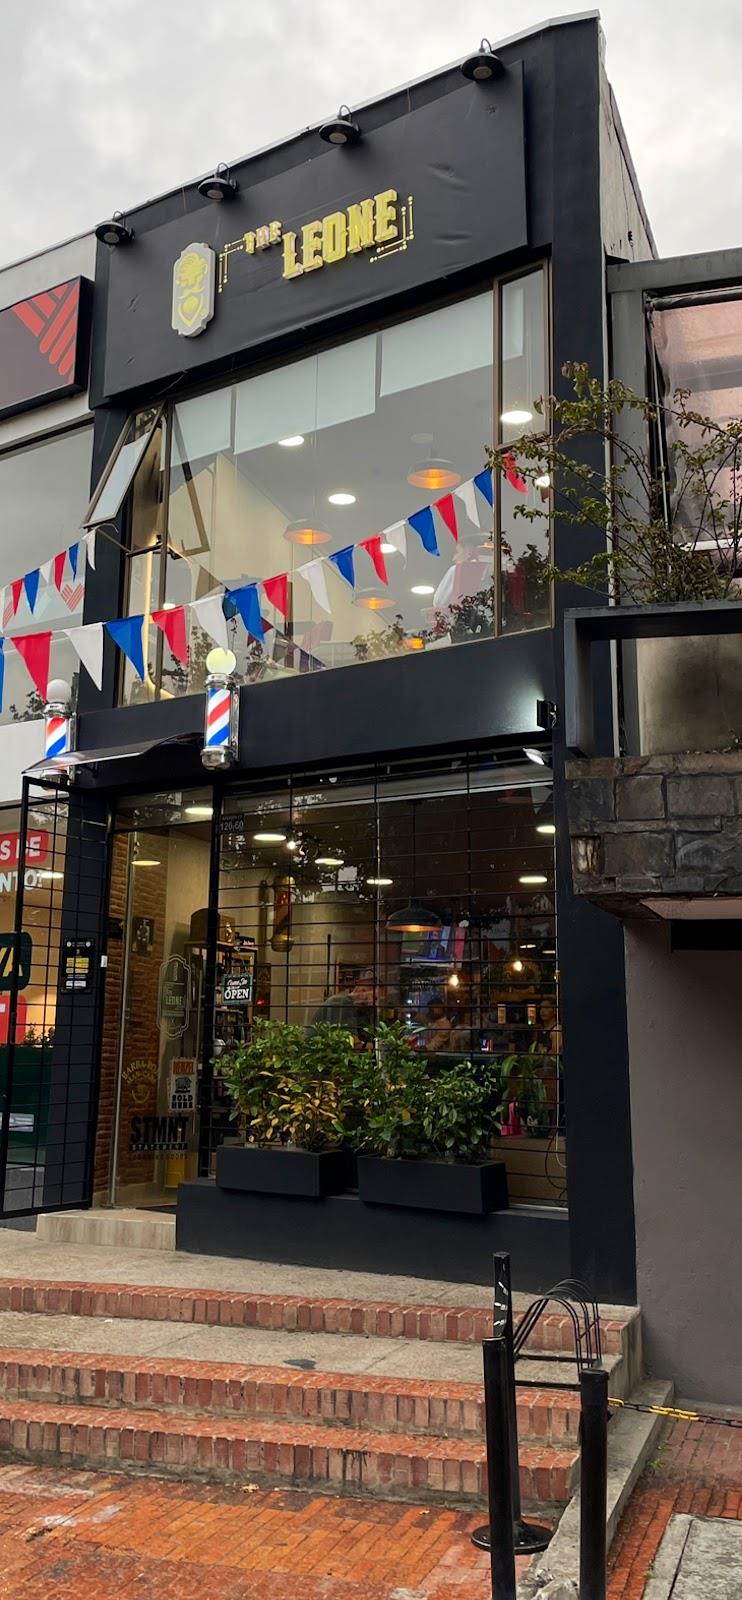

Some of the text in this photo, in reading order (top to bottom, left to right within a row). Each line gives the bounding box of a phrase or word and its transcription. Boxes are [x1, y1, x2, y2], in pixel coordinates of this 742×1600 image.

[243, 188, 398, 280] THE LEONE
[15, 836, 41, 858] DE
[224, 988, 249, 1000] OPEN
[172, 1094, 193, 1102] SOLD
[130, 1116, 188, 1143] STMNT
